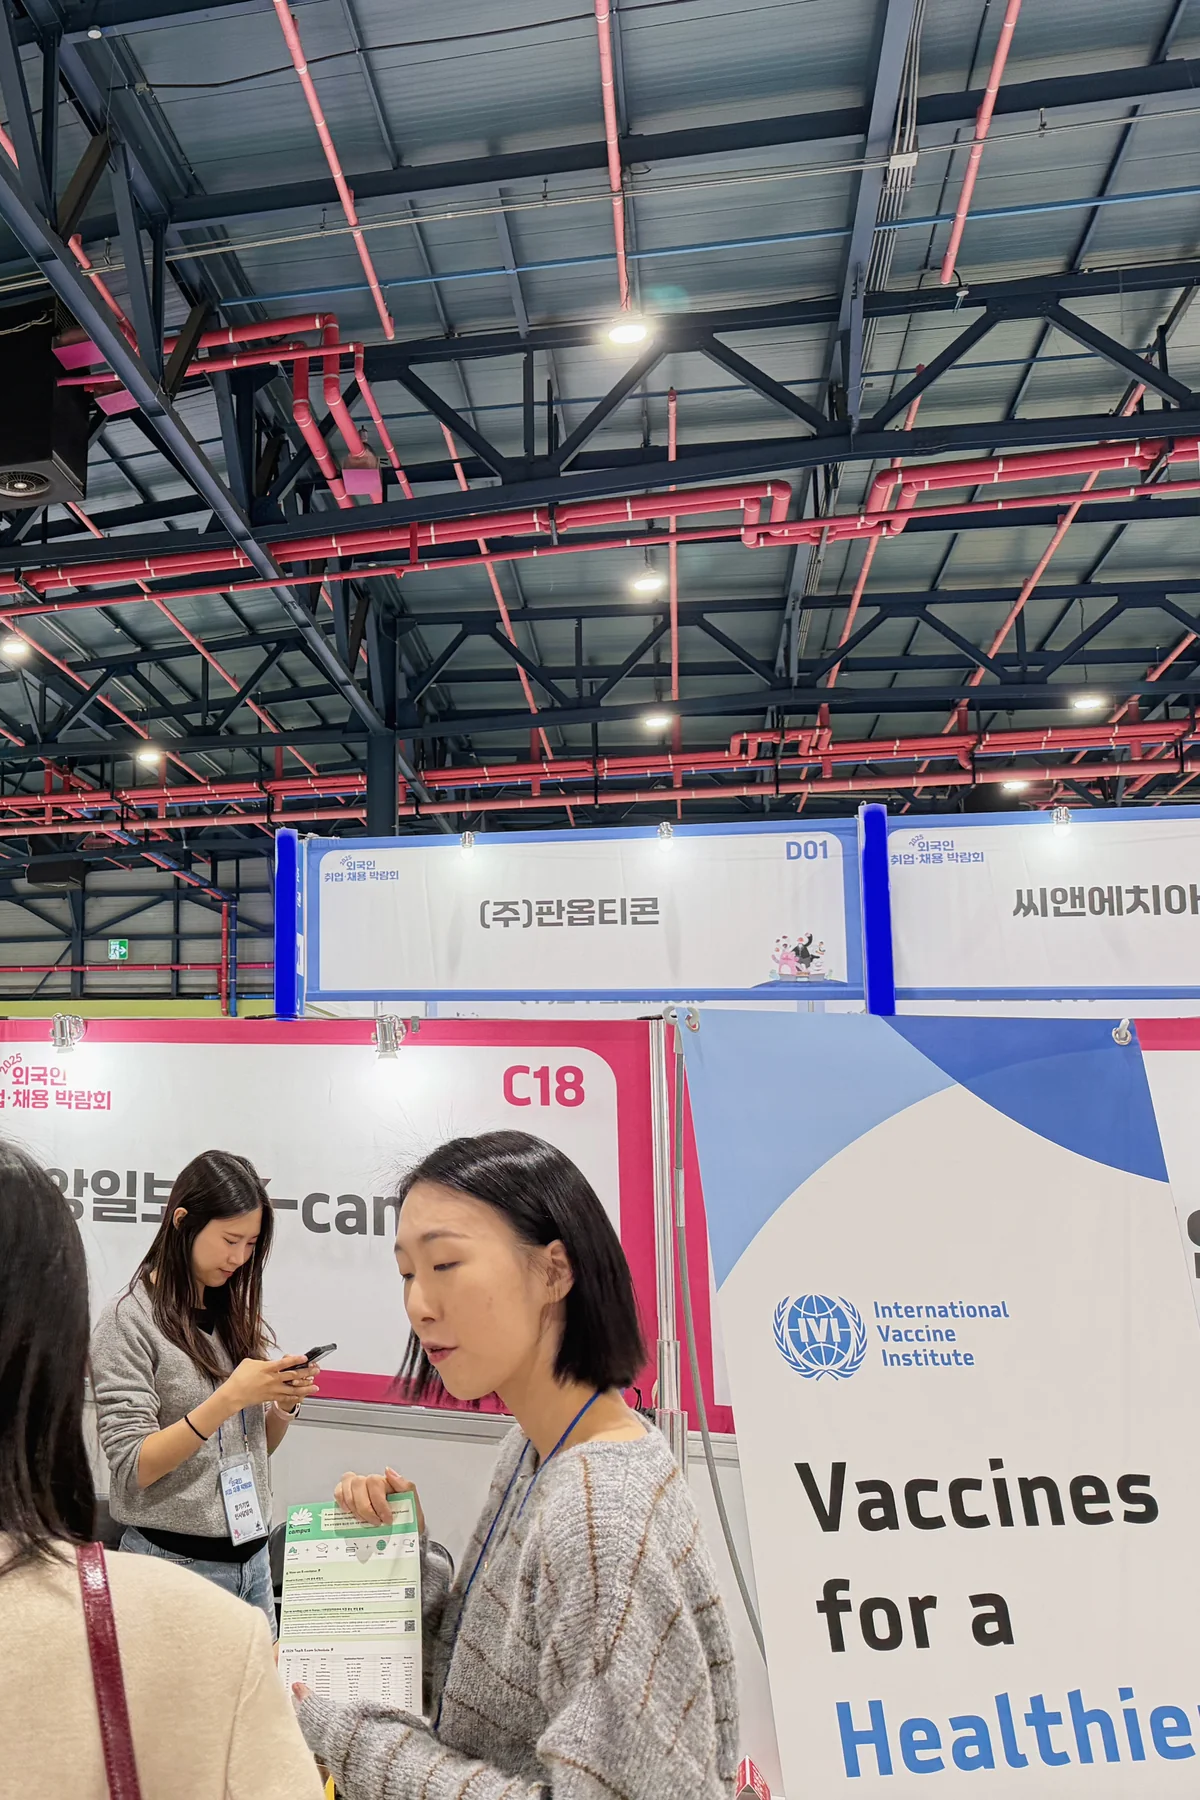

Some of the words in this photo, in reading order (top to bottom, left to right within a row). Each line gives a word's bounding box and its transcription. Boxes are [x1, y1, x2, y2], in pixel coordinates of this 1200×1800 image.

[786, 840, 828, 860] D01
[917, 840, 954, 852] 외국인
[346, 860, 376, 871] 외국인
[947, 851, 984, 863] 박람회
[369, 870, 399, 881] 박람회
[1013, 884, 1200, 917] 씨앤에치아
[480, 897, 659, 928] (주)판옵티콘
[12, 1066, 67, 1086] 외국인
[503, 1065, 585, 1107] C18
[55, 1090, 111, 1110] 박람회
[45, 1168, 177, 1225] 앙일보
[873, 1301, 1009, 1319] International
[797, 1317, 841, 1342] IVI
[876, 1325, 956, 1342] Vaccine
[881, 1349, 975, 1367] Institute
[794, 1458, 1159, 1532] Vaccines
[816, 1579, 937, 1652] for
[968, 1593, 1015, 1646] a
[836, 1687, 1200, 1778] Healthie
